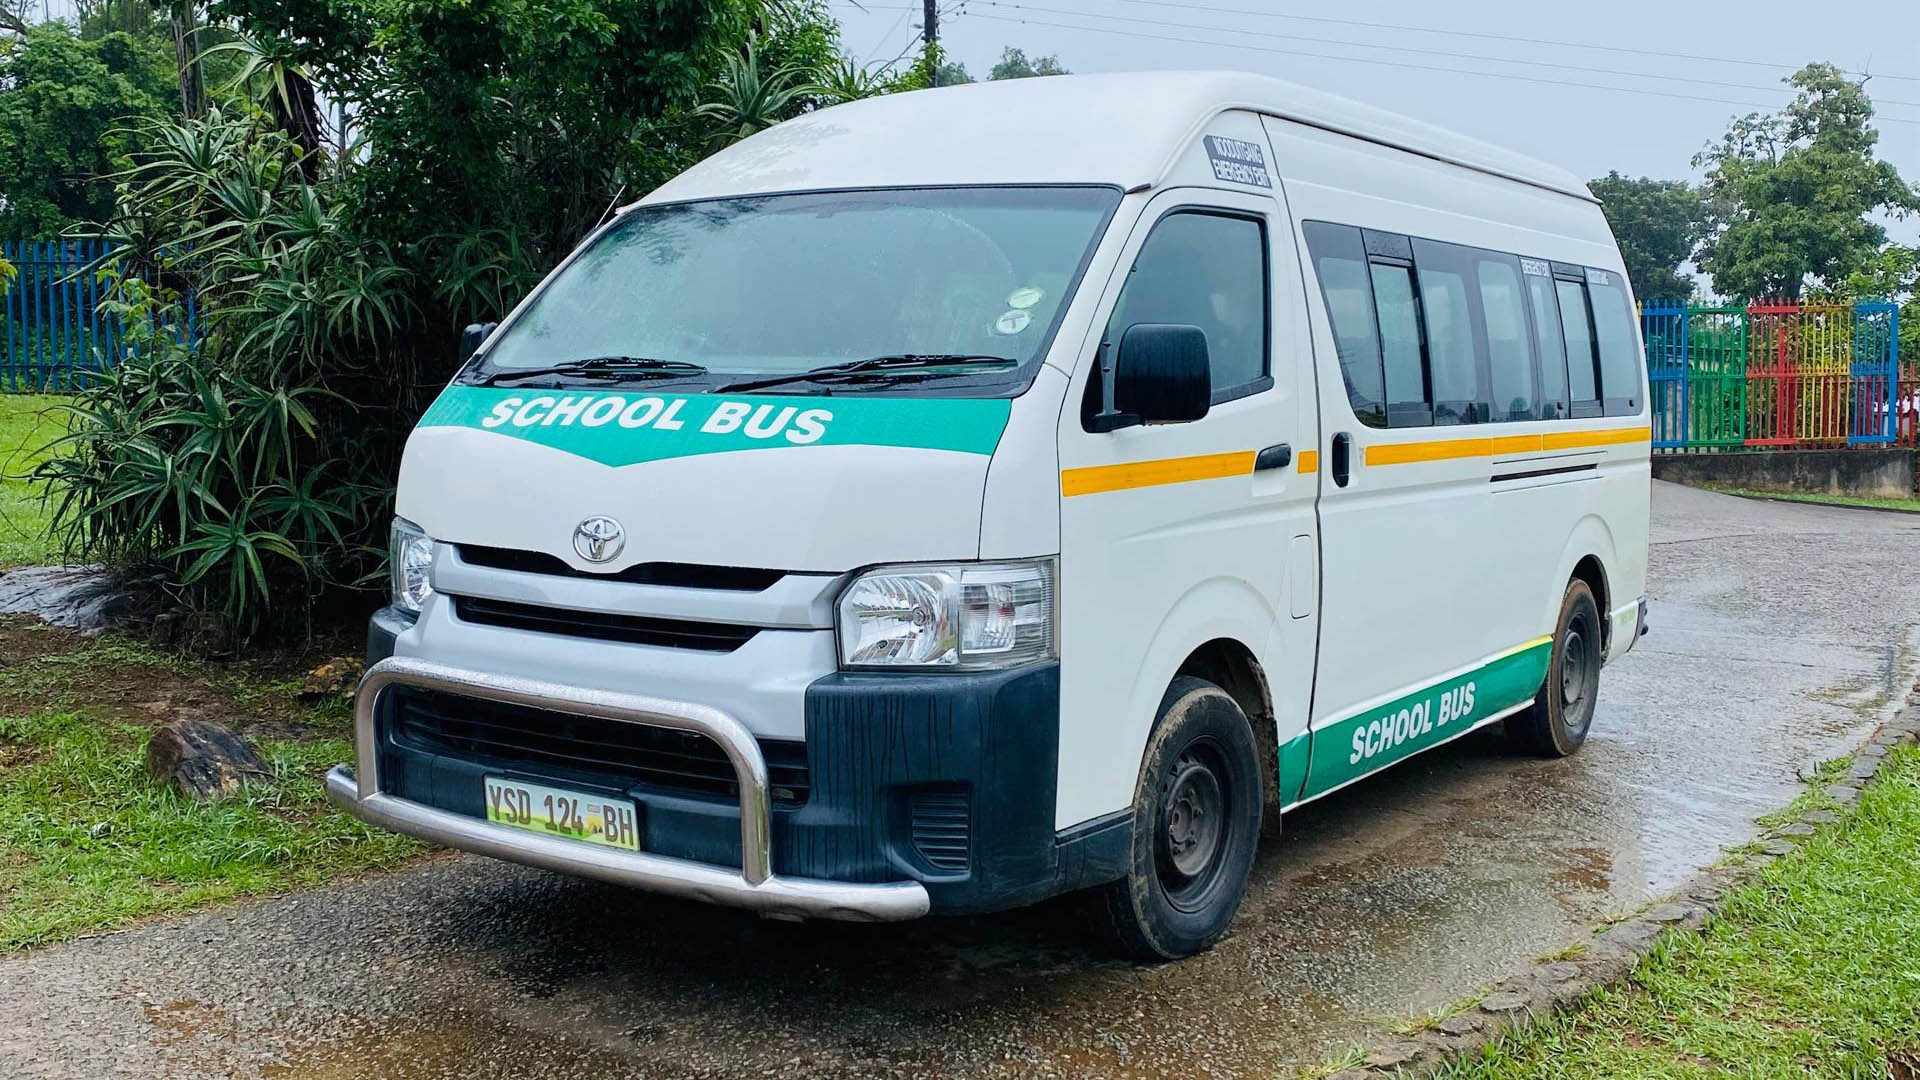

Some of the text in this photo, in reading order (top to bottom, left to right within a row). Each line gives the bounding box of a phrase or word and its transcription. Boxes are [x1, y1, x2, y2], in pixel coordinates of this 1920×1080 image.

[482, 396, 833, 444] SCHOOL BUS
[1350, 681, 1476, 765] SCHOOL BUS
[488, 784, 634, 846] YSD 124 BH
